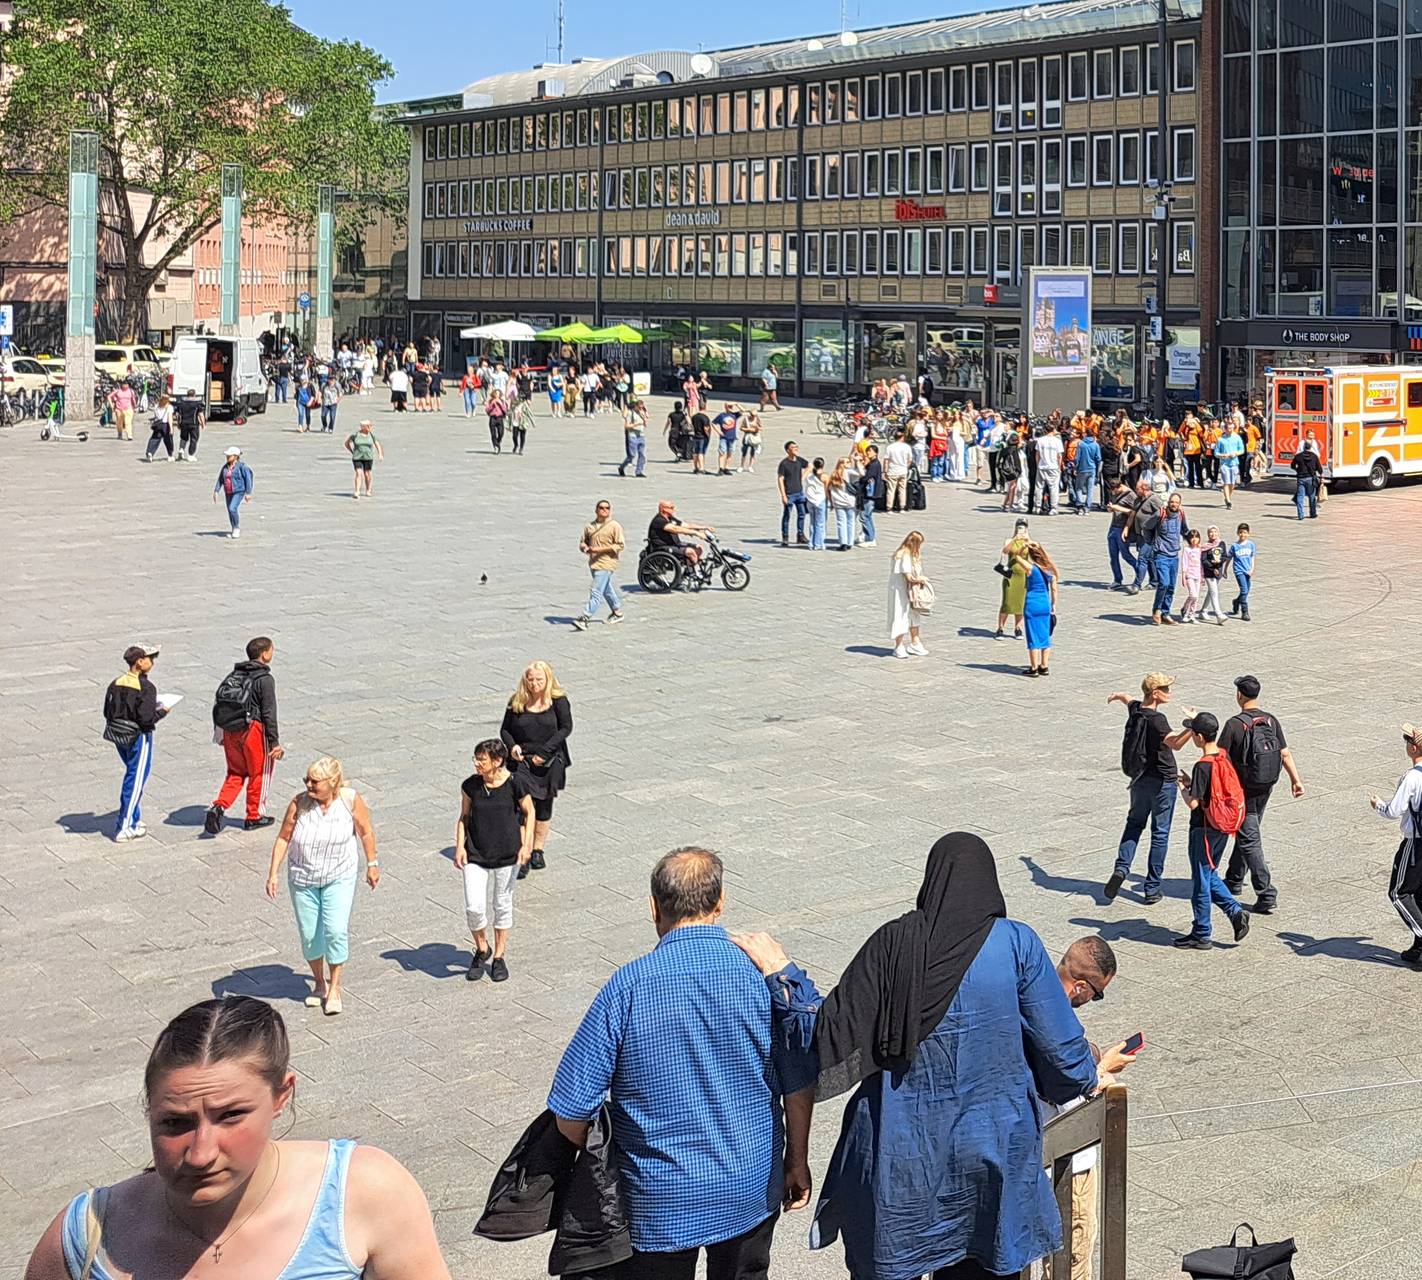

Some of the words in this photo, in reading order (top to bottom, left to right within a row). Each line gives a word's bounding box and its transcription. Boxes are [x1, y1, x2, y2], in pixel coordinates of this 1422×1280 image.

[463, 219, 503, 233] STARBUCKS
[503, 218, 531, 231] COFFEE
[1294, 331, 1309, 342] THE
[1310, 331, 1329, 342] BODY
[1329, 332, 1350, 343] SHOP
